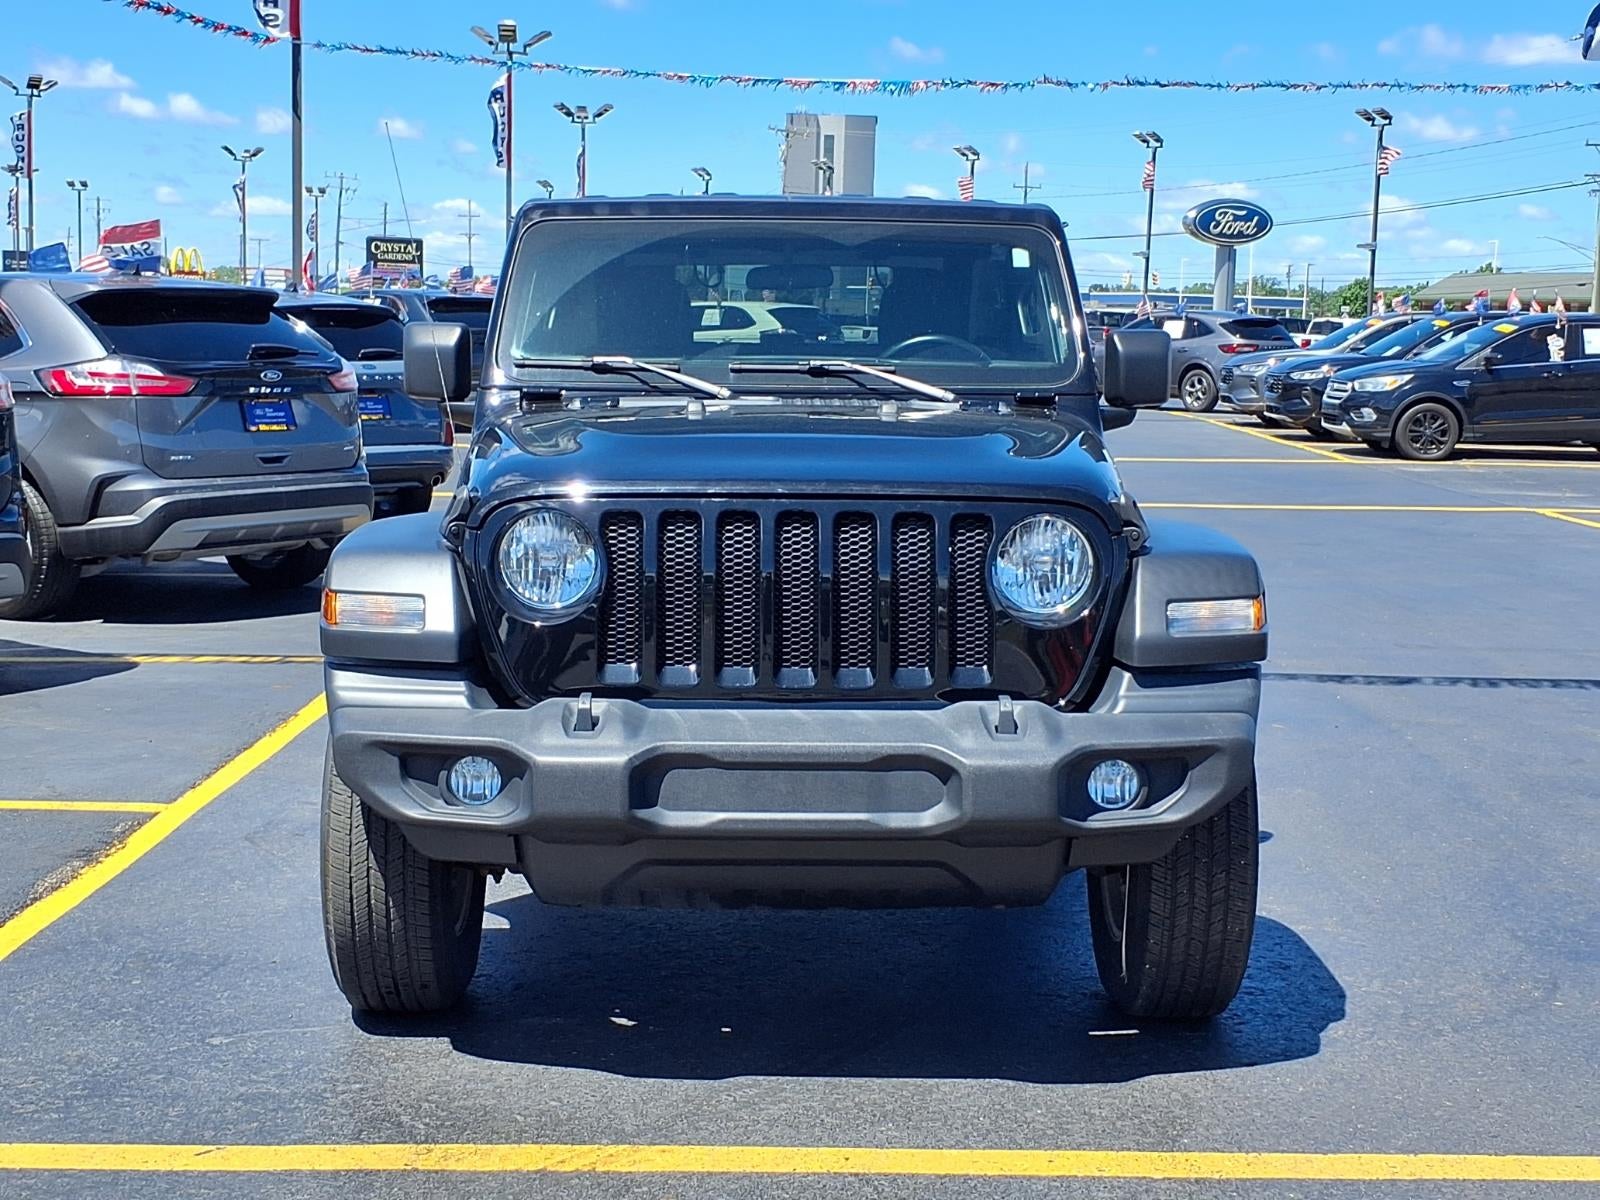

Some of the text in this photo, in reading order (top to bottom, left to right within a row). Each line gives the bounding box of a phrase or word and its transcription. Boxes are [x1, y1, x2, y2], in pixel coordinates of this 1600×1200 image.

[1209, 208, 1260, 236] Ford
[371, 241, 421, 256] CRYSTAL
[377, 252, 413, 261] GARDENS
